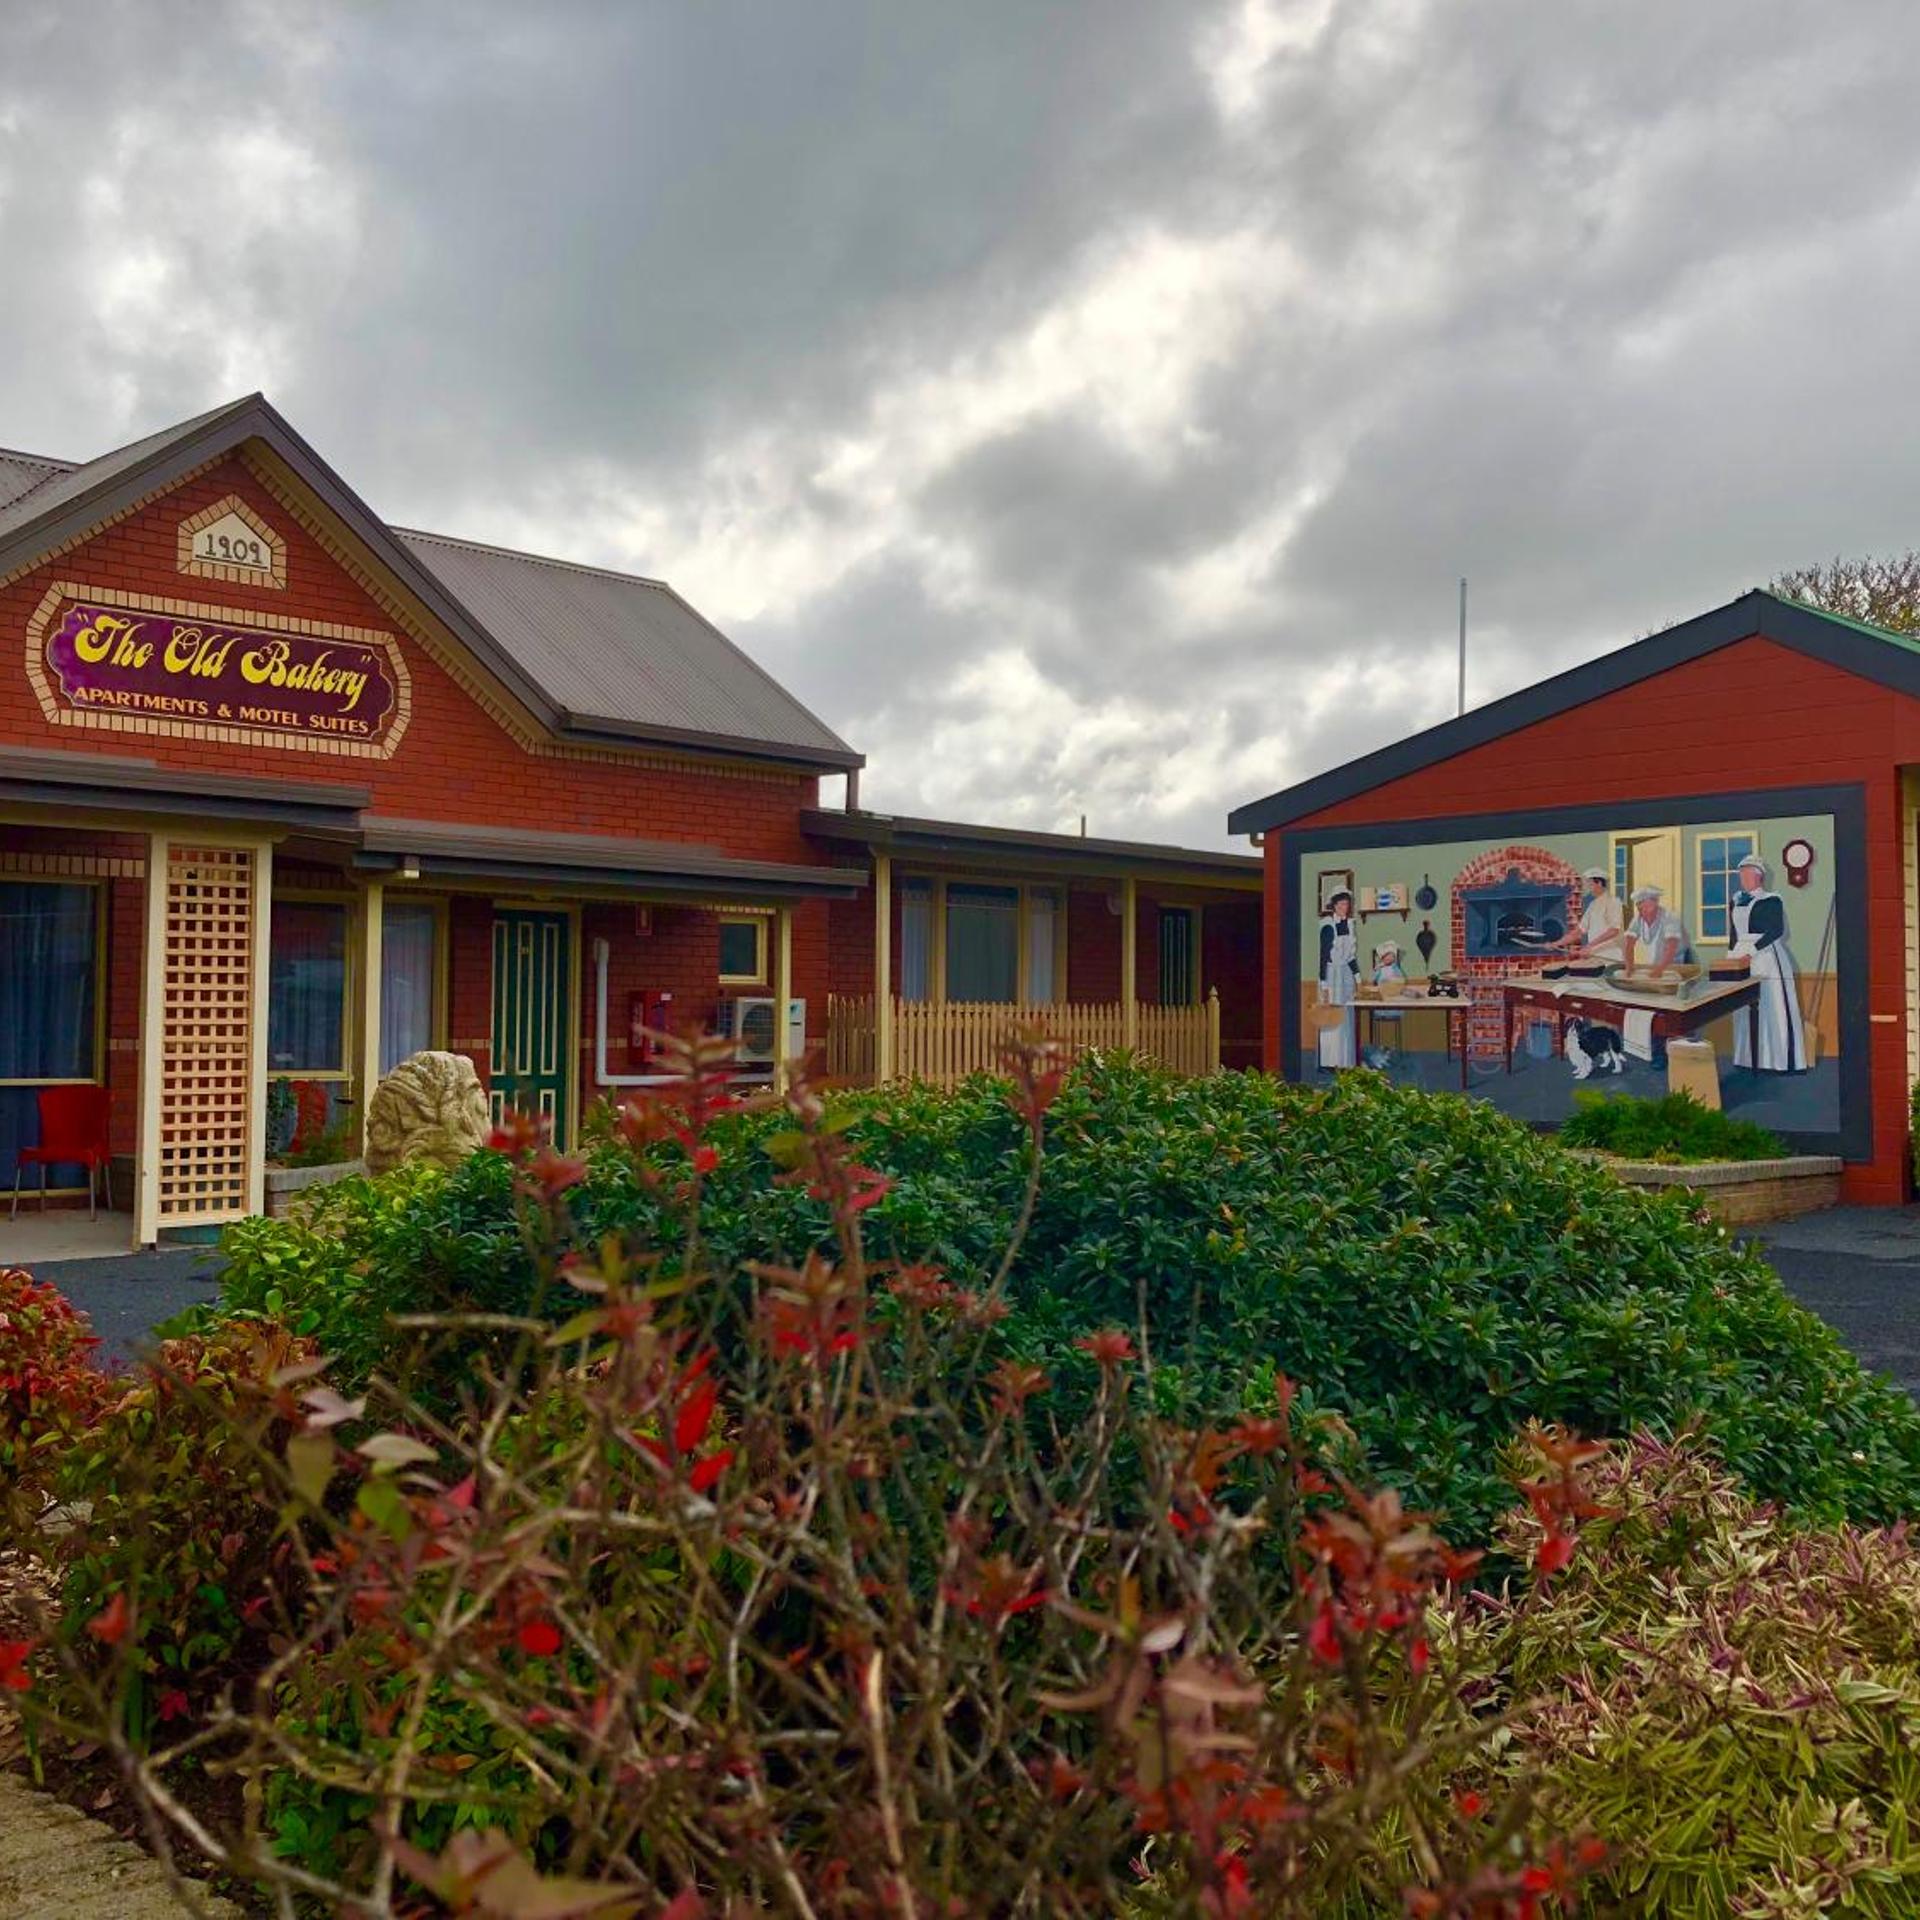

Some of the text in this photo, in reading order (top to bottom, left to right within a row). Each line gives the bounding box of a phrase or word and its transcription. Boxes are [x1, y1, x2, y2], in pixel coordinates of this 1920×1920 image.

[204, 532, 262, 564] 1909
[164, 626, 243, 678] Old
[73, 686, 369, 733] APARTMENTS & MOTEL SUITES
